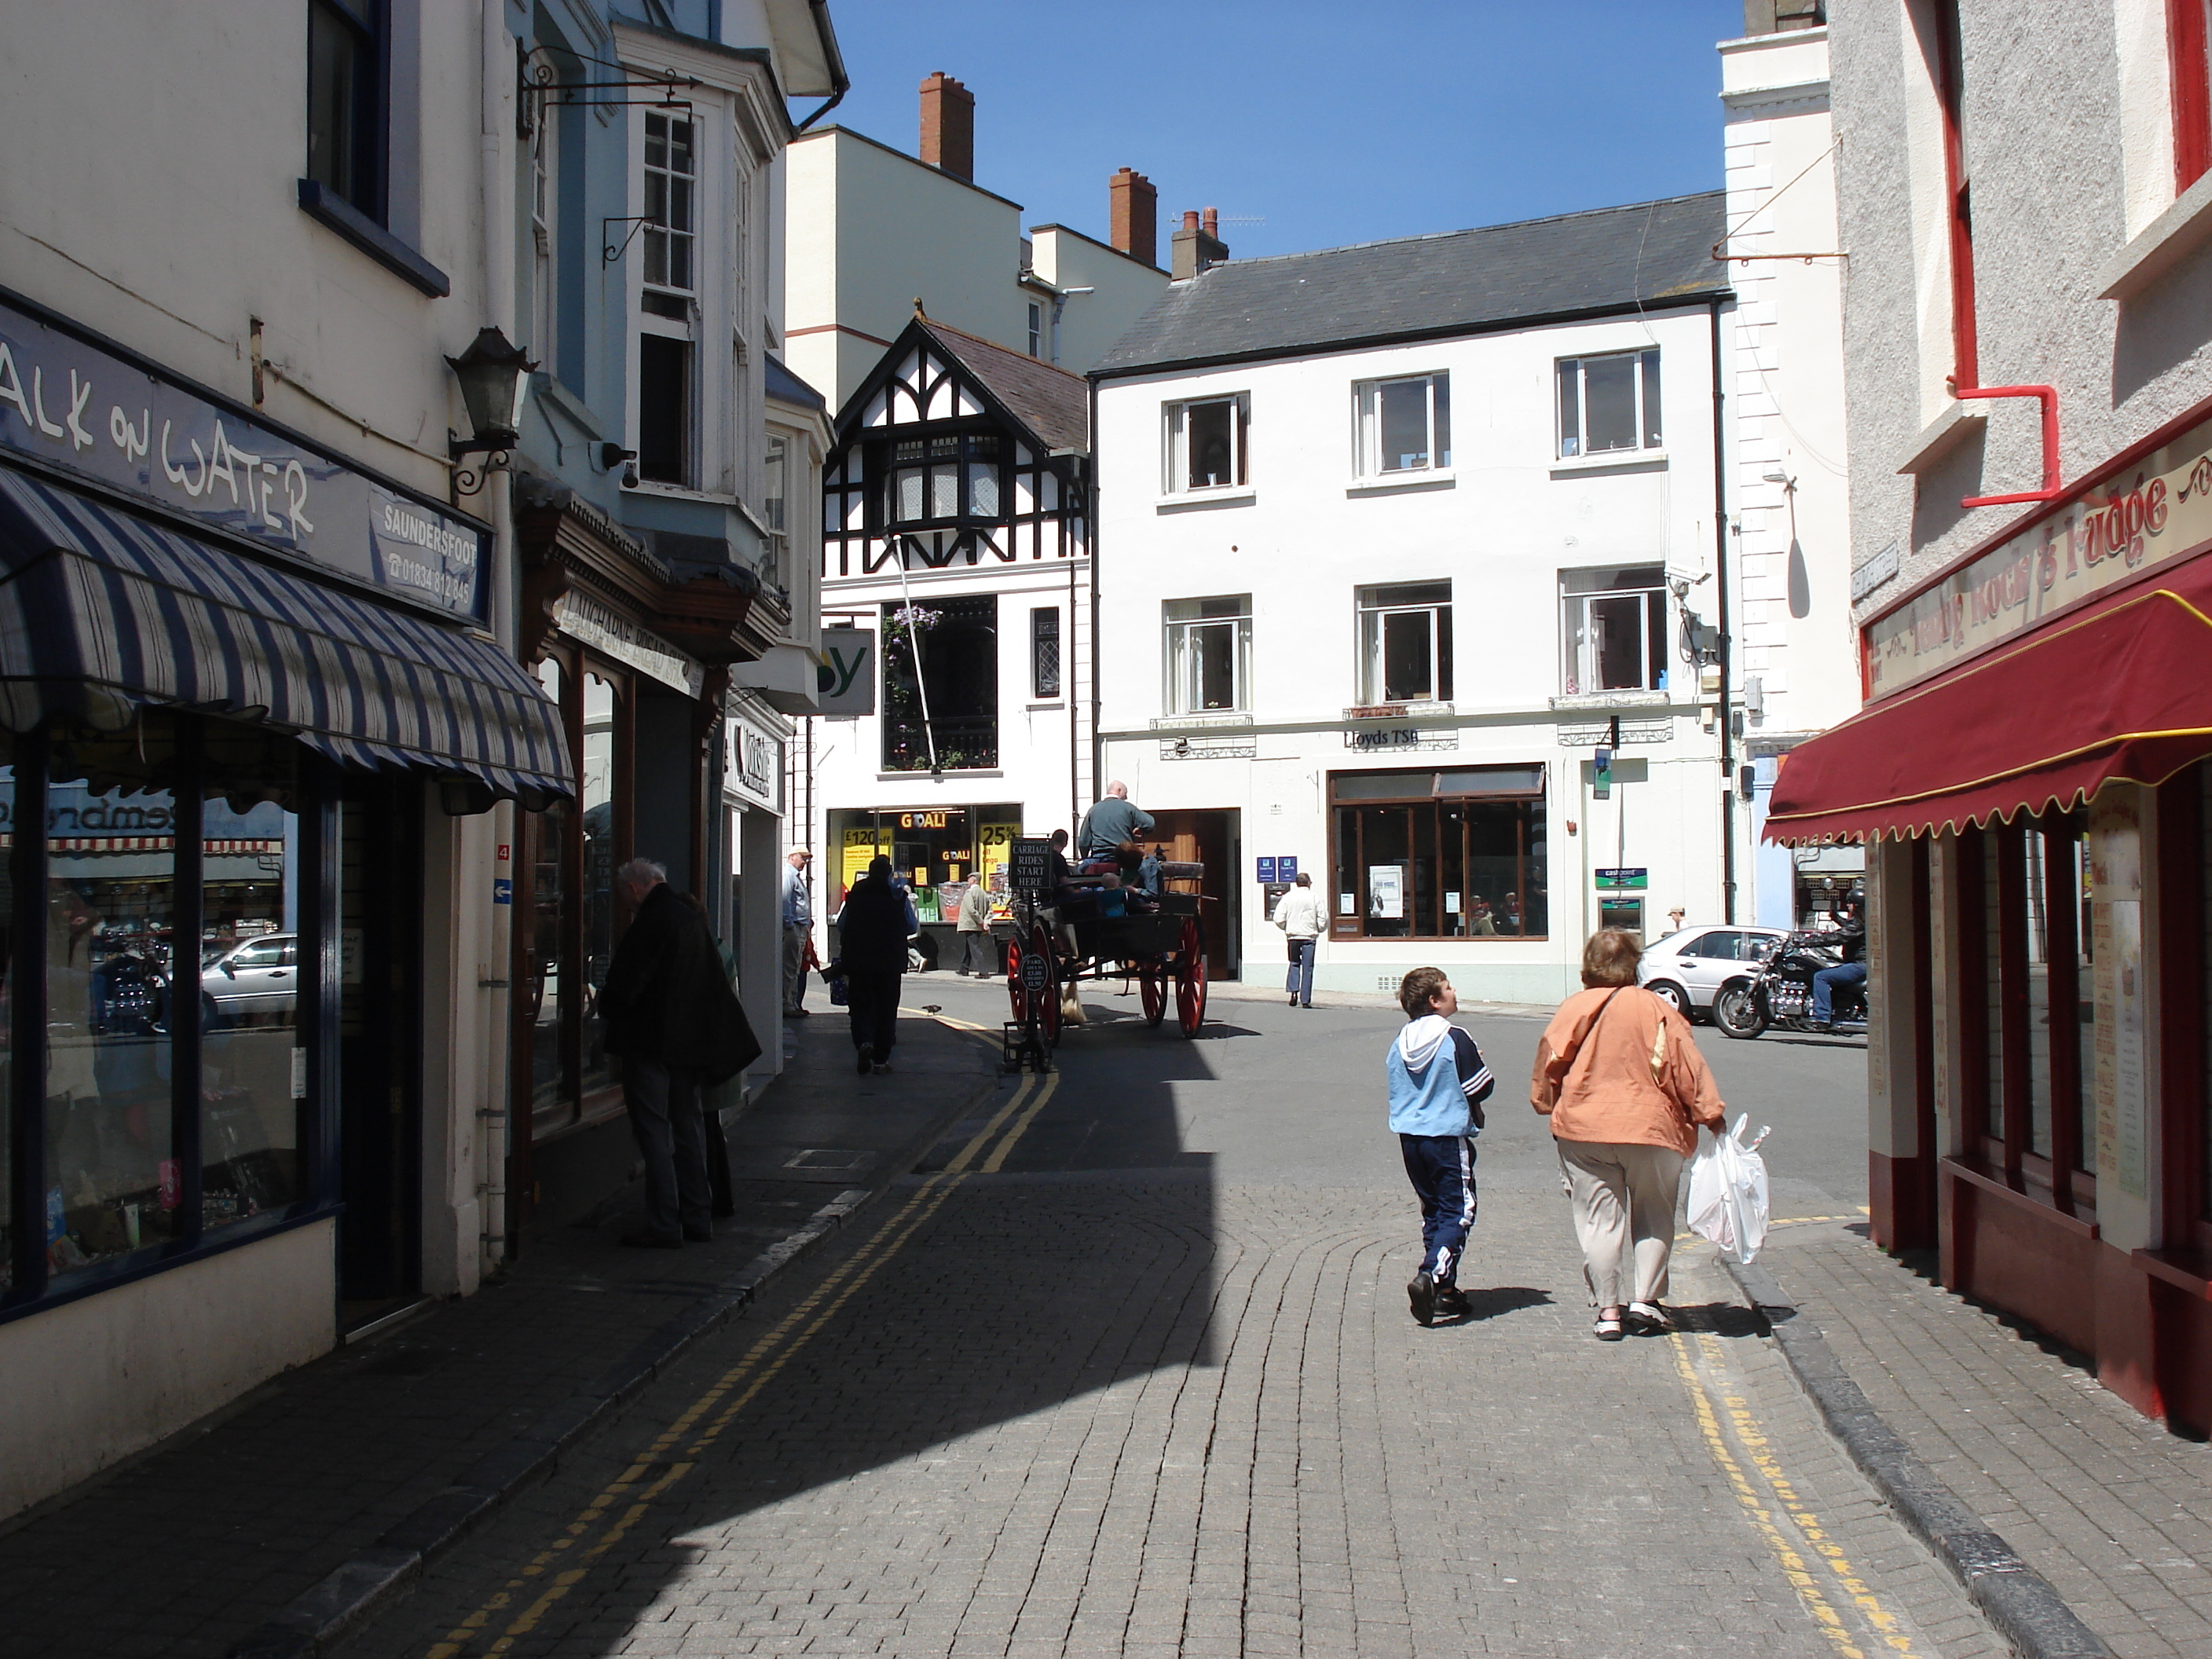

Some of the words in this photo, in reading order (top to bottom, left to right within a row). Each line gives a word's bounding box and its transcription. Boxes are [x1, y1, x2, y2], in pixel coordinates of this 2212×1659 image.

[109, 405, 150, 463] ON
[160, 419, 314, 541] WATER
[384, 504, 478, 567] SAUNDERSFOOT
[403, 558, 432, 590] 01834
[434, 571, 451, 597] 812
[452, 580, 469, 604] 845
[501, 847, 508, 858] 4
[1013, 845, 1049, 855] CARRIAGE
[1018, 856, 1044, 865] RIDES
[1016, 866, 1045, 876] START
[1018, 877, 1042, 886] HERE
